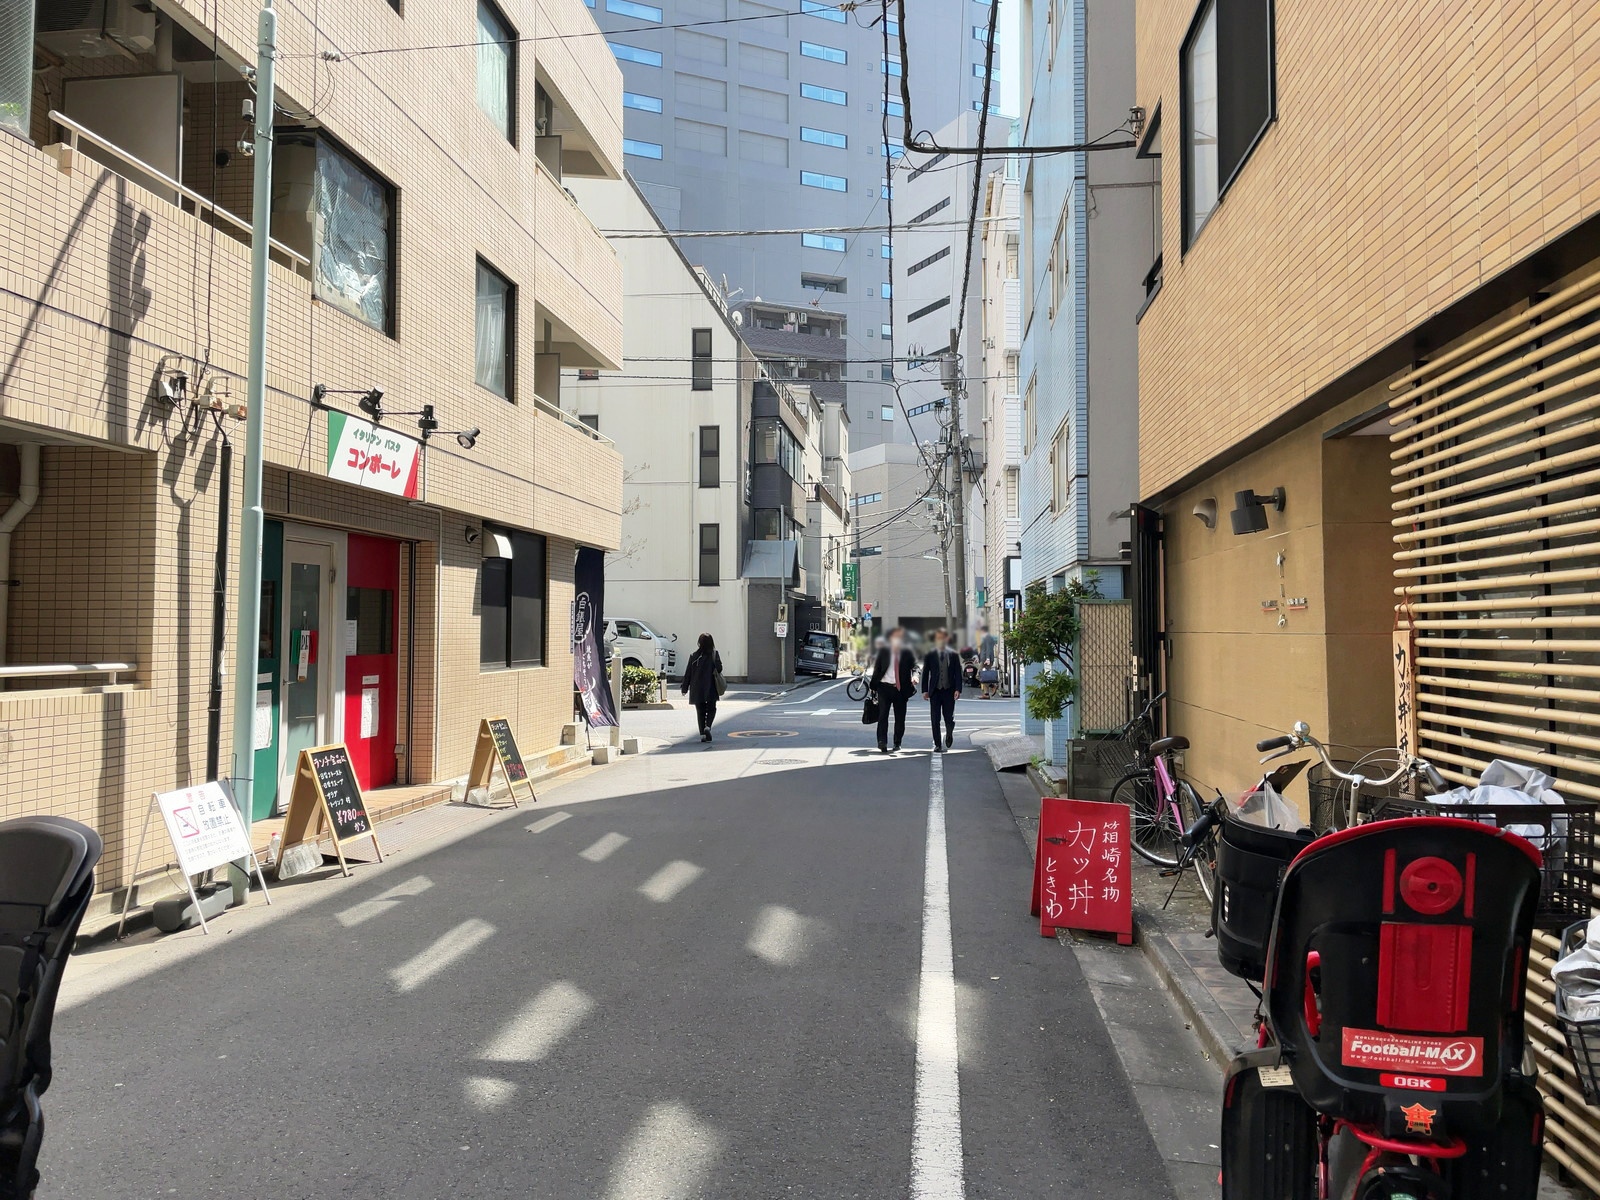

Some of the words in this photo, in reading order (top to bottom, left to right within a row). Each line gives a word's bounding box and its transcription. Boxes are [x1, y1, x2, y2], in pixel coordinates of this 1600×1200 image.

[353, 428, 382, 446] イタリアン
[384, 438, 401, 453] パスタ
[347, 447, 401, 479] コンボーレ
[1068, 820, 1097, 915] カツ丼
[1101, 820, 1122, 903] 箱崎名物
[1045, 856, 1063, 919] ときわ
[1350, 1054, 1438, 1065] www.football-max.com
[1351, 1040, 1466, 1061] Football-MAX
[1393, 1076, 1432, 1089] OGK
